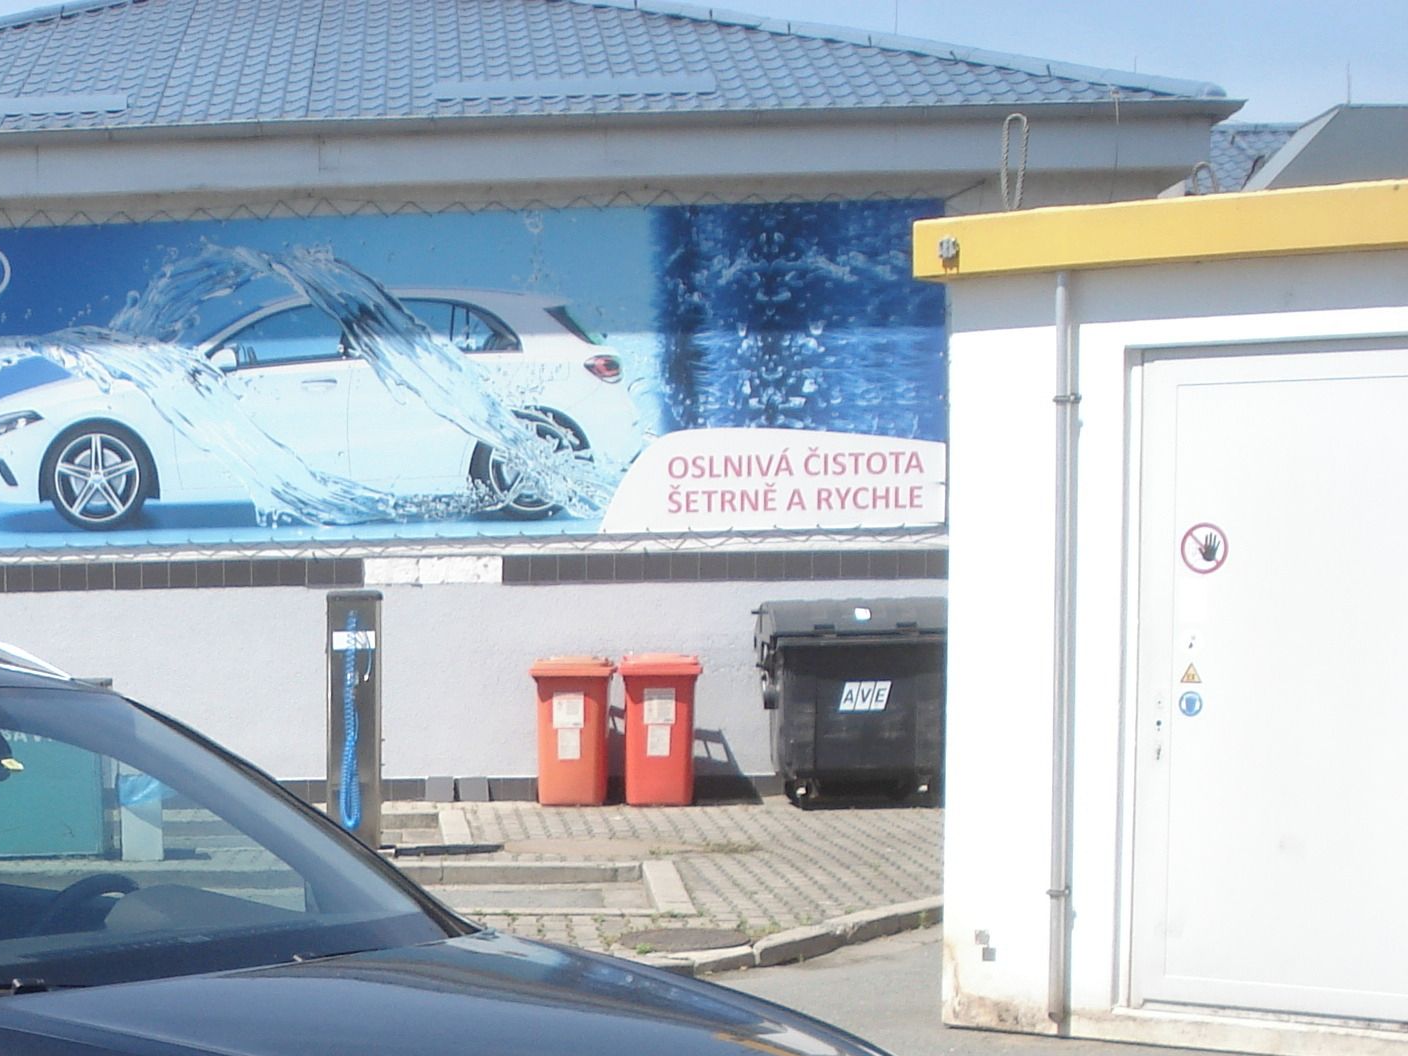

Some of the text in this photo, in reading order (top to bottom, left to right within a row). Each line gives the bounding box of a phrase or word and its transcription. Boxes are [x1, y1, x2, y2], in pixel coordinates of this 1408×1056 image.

[667, 447, 925, 479] OSLNIVÁ ČISTOTA
[667, 482, 924, 514] ŠETRNĚ A RYCHLE
[843, 687, 887, 703] AVE
